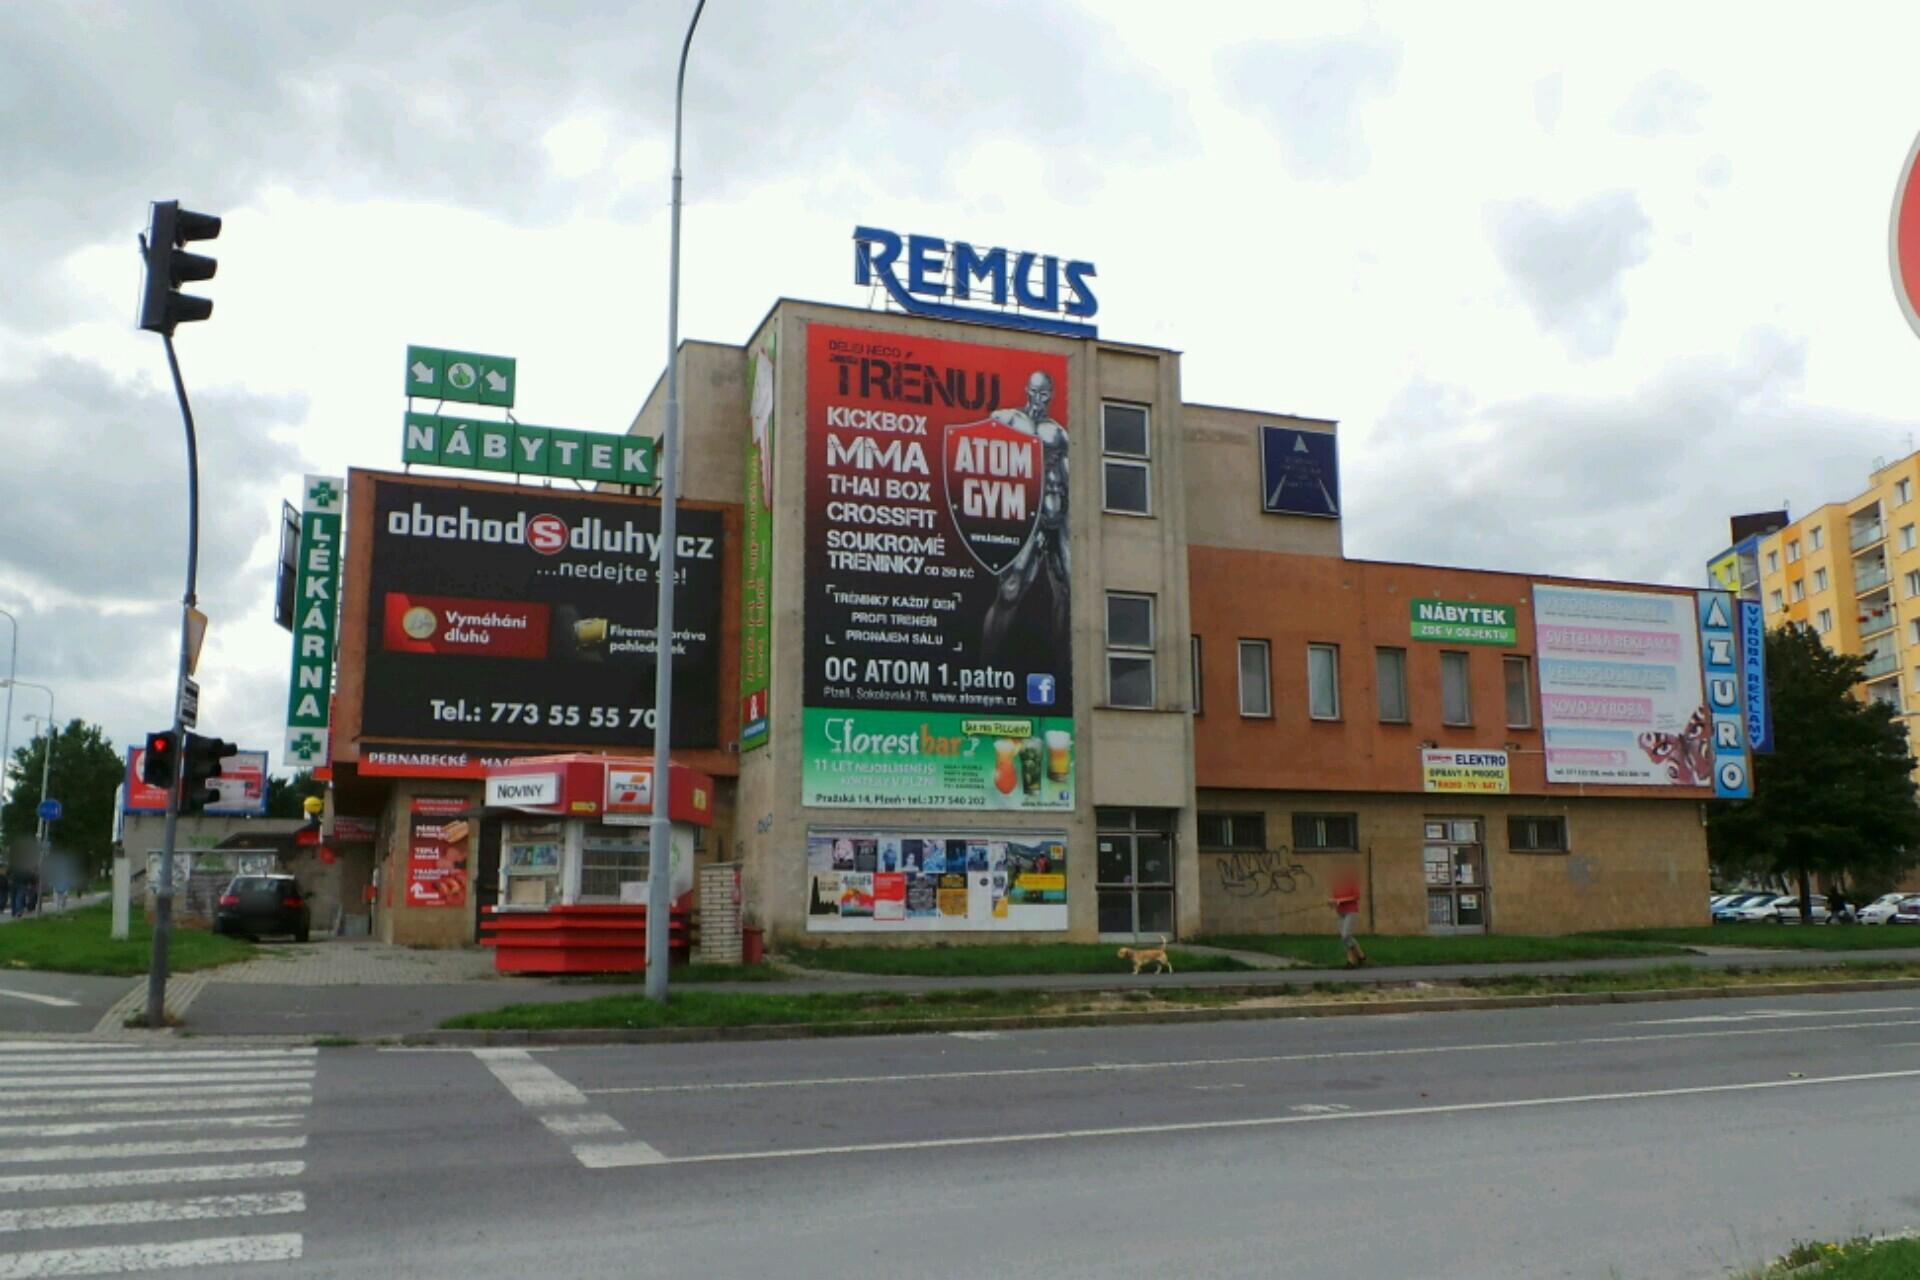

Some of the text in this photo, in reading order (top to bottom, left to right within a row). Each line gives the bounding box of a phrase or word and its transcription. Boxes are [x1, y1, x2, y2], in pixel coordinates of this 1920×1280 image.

[852, 225, 1098, 337] REMUS
[829, 352, 999, 411] TRÉNUJ
[827, 406, 927, 435] KICKBOX
[406, 424, 649, 473] NÁBYTEK
[827, 433, 930, 475] MMA
[954, 436, 1032, 478] ATOM
[827, 474, 931, 501] THAI BOX
[963, 479, 1025, 520] GYM
[826, 501, 937, 529] CROSSFIT
[826, 529, 945, 556] SOUKROMÉ
[295, 518, 331, 718] LÉKÁRNA
[851, 612, 888, 624] PROFI
[932, 599, 956, 610] DEN
[1419, 602, 1507, 625] NÁBYTEK
[445, 610, 527, 629] Vymáhání
[1422, 625, 1442, 635] ZDE
[1446, 626, 1453, 636] V
[444, 629, 490, 644] dluhů
[912, 632, 943, 645] SÁLU
[824, 657, 1015, 691] OC ATOM 1.patro
[1705, 597, 1744, 790] AZURO
[430, 699, 481, 722] Tel.:
[491, 703, 538, 725] 773
[548, 706, 580, 727] 55
[589, 708, 620, 728] 55
[1747, 673, 1762, 745] REKLAMY
[369, 752, 468, 767] PERNARECKÉ
[815, 759, 826, 772] 11
[1455, 754, 1506, 767] ELEKTRO
[497, 783, 544, 799] NOVINY
